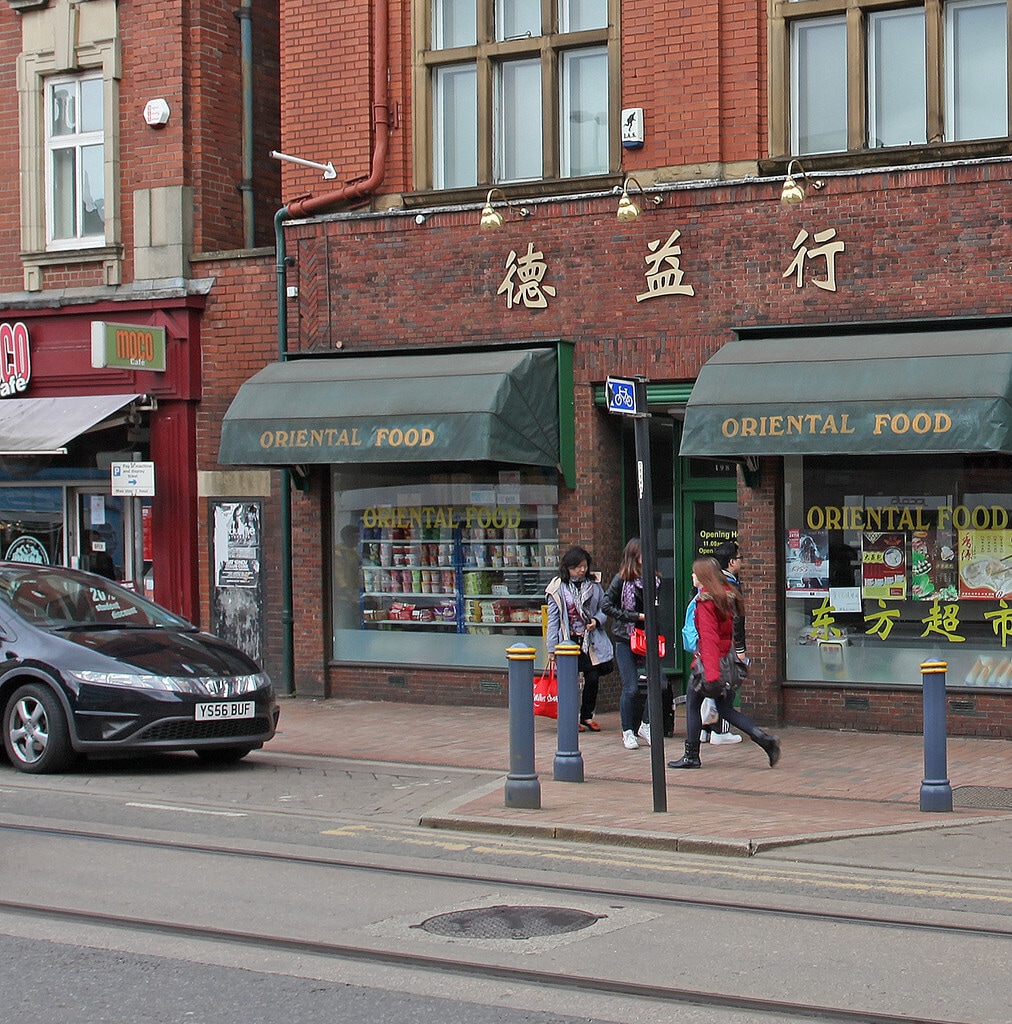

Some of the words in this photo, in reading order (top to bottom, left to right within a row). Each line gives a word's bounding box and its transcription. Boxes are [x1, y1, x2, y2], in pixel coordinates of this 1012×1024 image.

[130, 357, 146, 366] Café
[721, 413, 855, 439] ORIENTAL
[872, 412, 953, 436] FOOD
[259, 428, 362, 450] ORIENTAL
[374, 428, 435, 448] FOOD
[363, 506, 459, 529] ORIENTAL
[465, 506, 522, 529] FOOD
[807, 505, 930, 531] ORIENTAL
[938, 505, 1009, 531] FOOD
[700, 530, 730, 540] Opening
[200, 704, 228, 717] YS56
[231, 702, 251, 716] BUF
